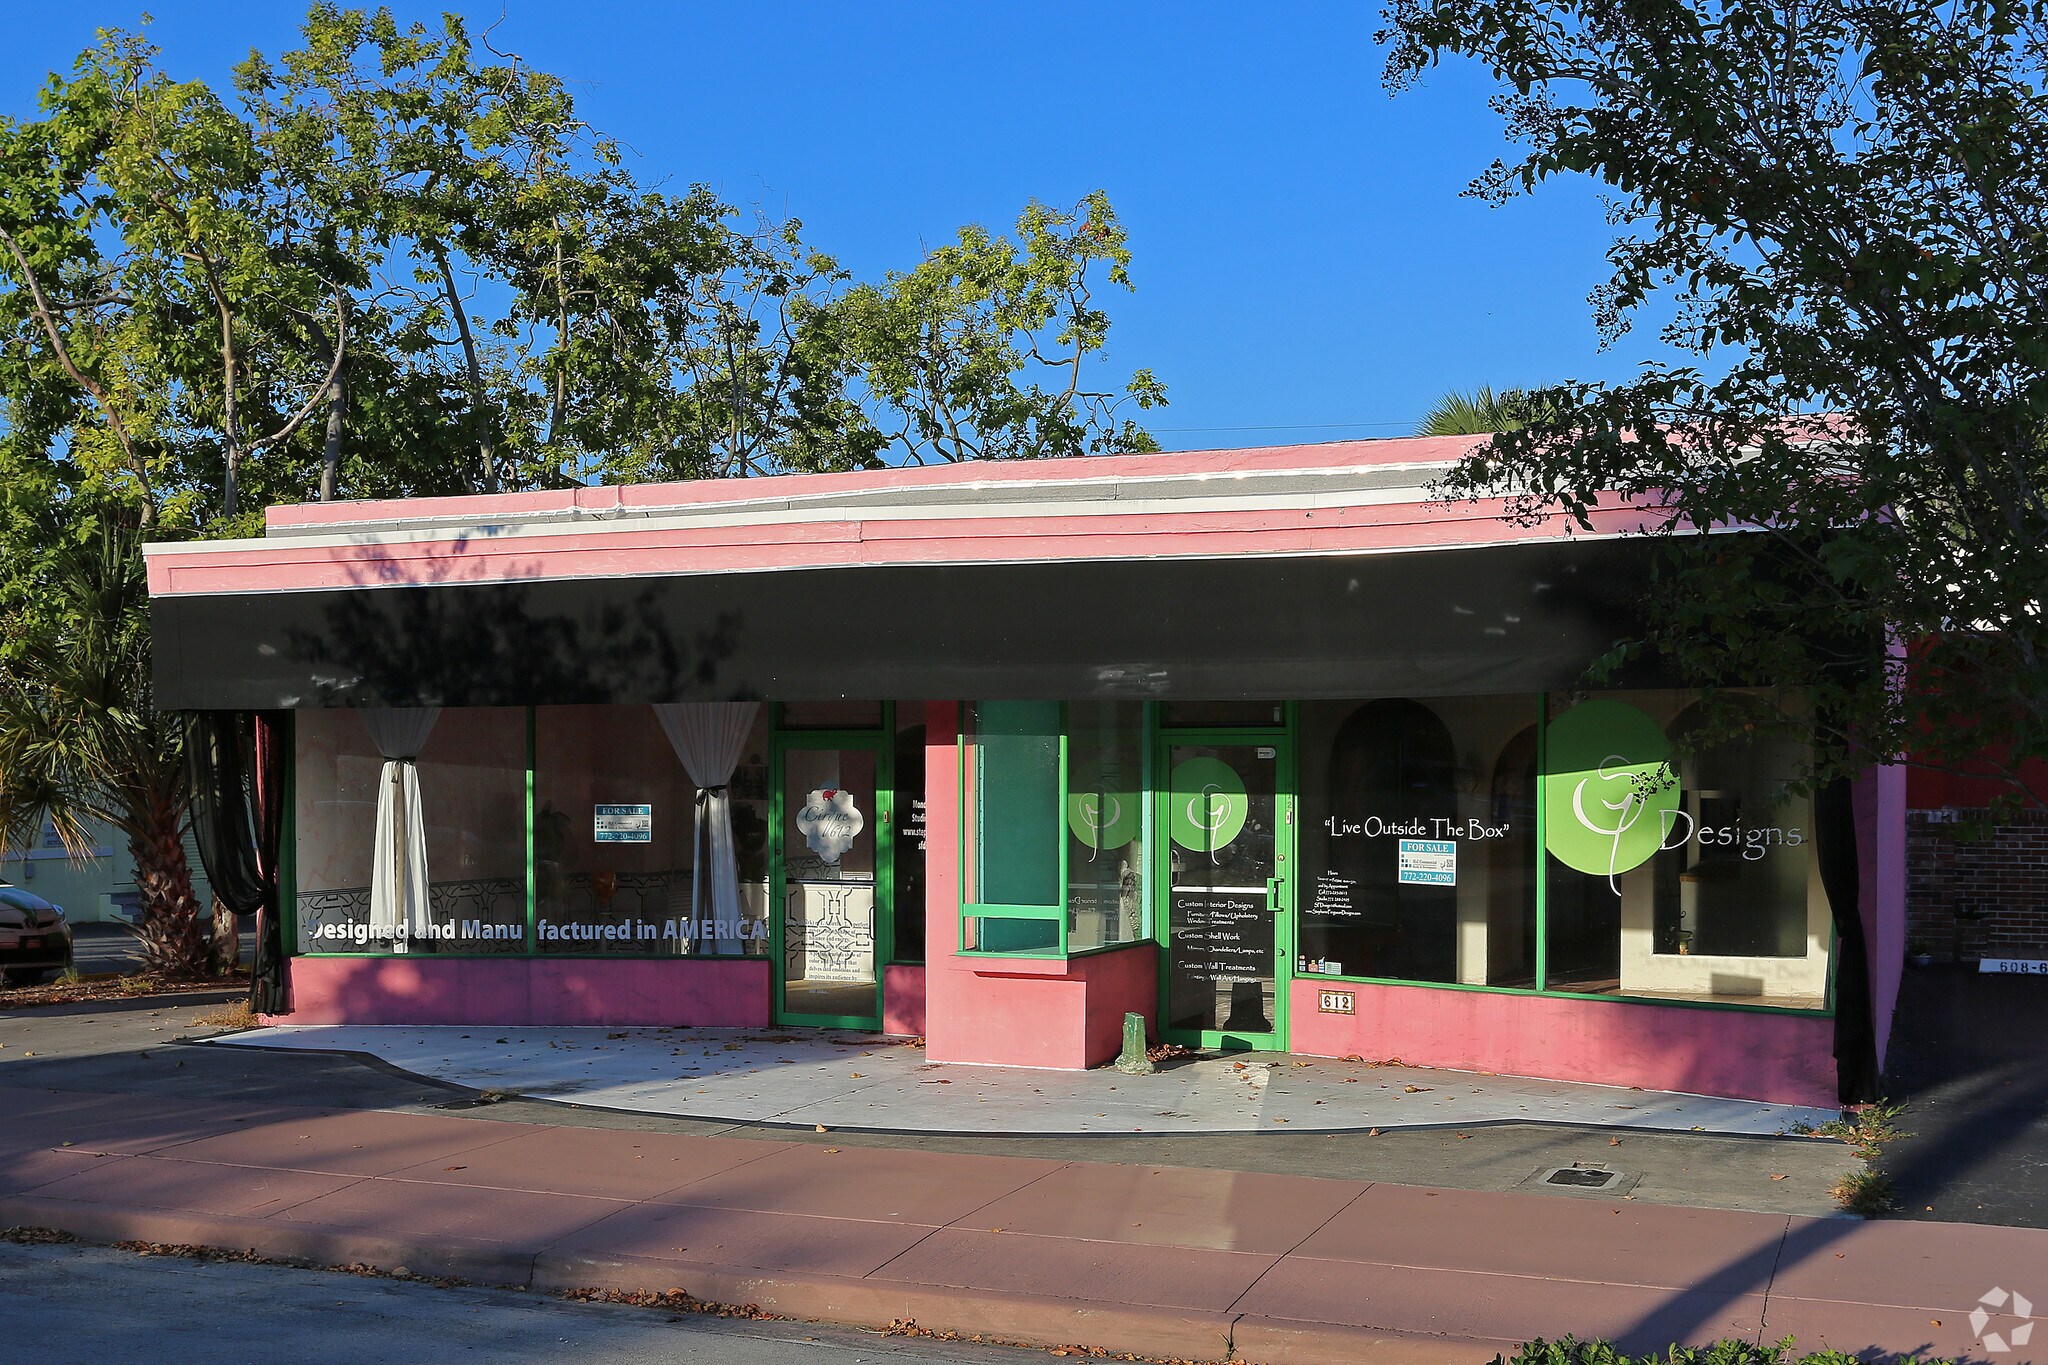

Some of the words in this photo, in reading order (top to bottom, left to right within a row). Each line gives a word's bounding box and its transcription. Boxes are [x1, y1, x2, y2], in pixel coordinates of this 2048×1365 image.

[602, 807, 620, 815] FOR
[621, 807, 644, 815] SALE
[1364, 816, 1427, 838] Outside
[1430, 818, 1464, 839] The
[600, 832, 648, 840] 772-220-4096
[1659, 809, 1804, 861] Designs
[1407, 842, 1425, 852] FOR
[1426, 843, 1449, 853] SALE
[1404, 872, 1452, 882] 772-220-4096
[1177, 899, 1203, 908] Custom
[1227, 900, 1254, 911] Designs
[308, 918, 409, 944] Designed
[414, 918, 456, 939] and
[461, 919, 522, 940] Manu
[537, 919, 631, 940] factured
[637, 919, 657, 939] in
[662, 919, 766, 939] AMERICA
[1178, 931, 1203, 939] Custom
[1204, 931, 1222, 940] Shell
[1222, 932, 1241, 941] Work
[1178, 960, 1203, 969] Custom
[1219, 962, 1256, 971] Treatments
[1324, 995, 1349, 1009] 612
